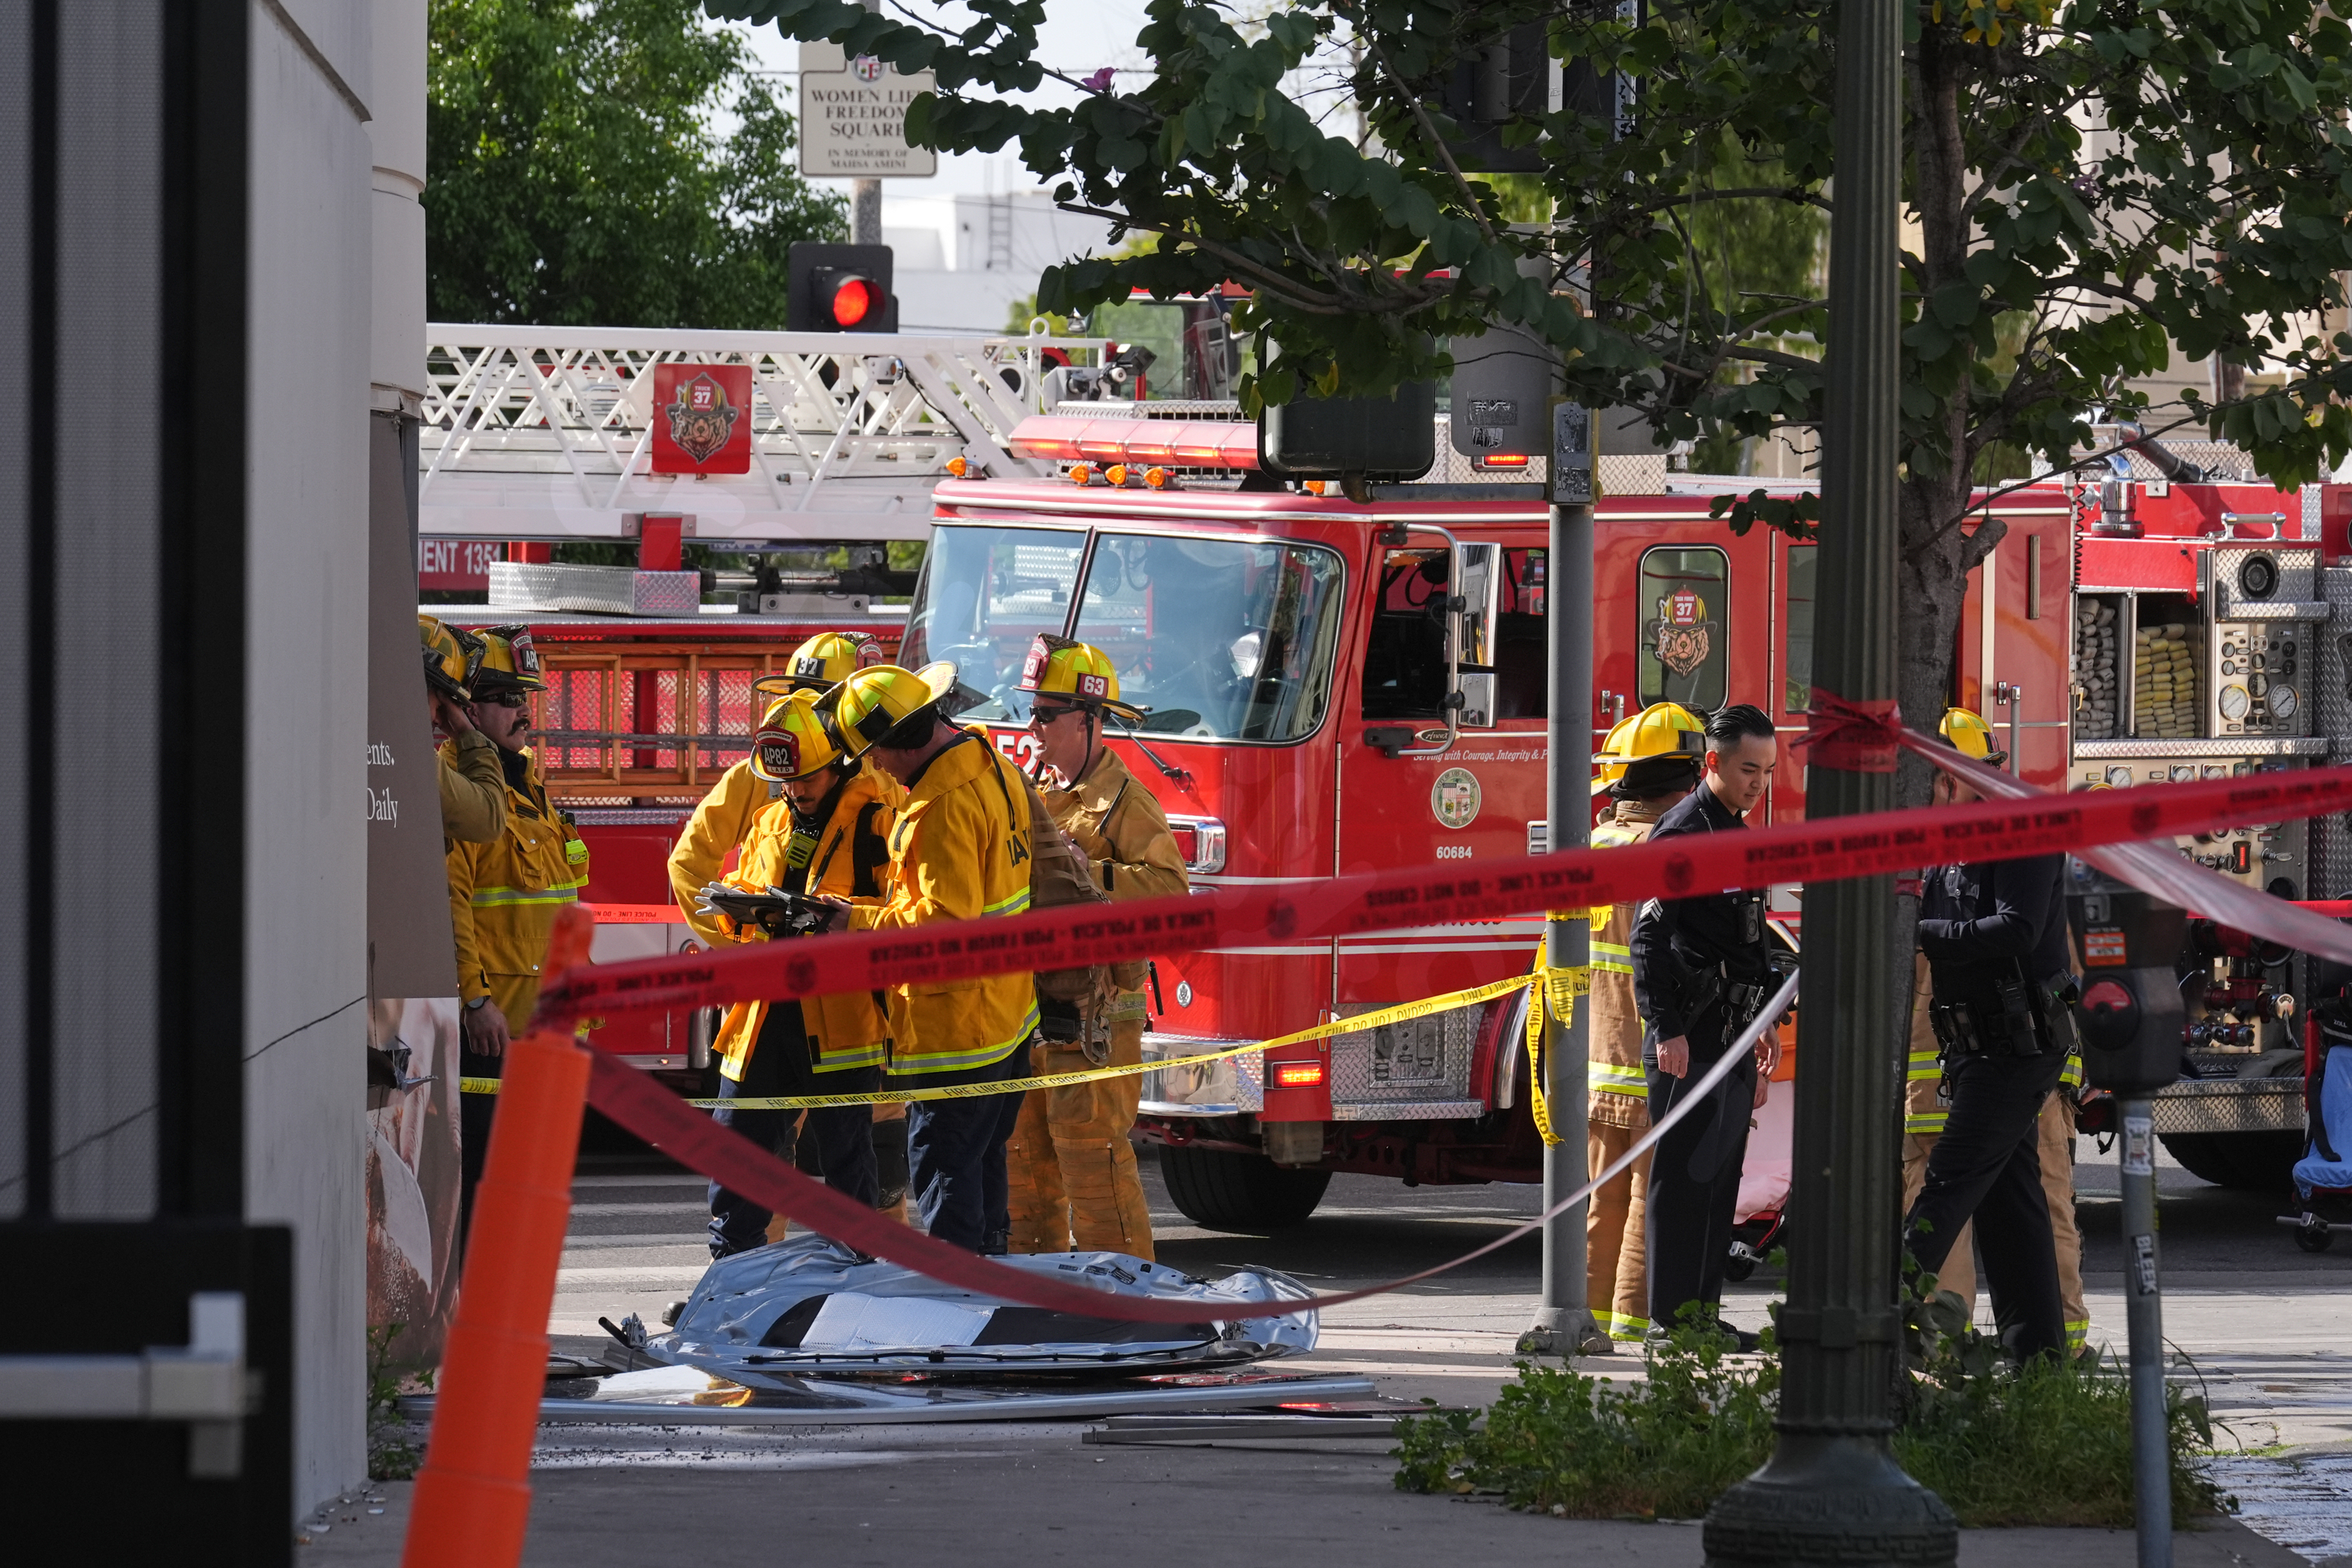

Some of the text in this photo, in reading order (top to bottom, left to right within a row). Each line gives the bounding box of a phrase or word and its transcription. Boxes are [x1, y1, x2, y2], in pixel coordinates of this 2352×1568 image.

[811, 89, 924, 103] WOMEN LIF
[830, 122, 904, 139] SQUARE
[828, 149, 908, 158] IN MEMORY OF
[830, 160, 906, 169] MAHSA AMINI
[694, 391, 711, 405] 37
[1676, 602, 1693, 616] 37
[798, 656, 818, 675] 37
[1023, 657, 1037, 676] 63
[1083, 675, 1105, 695] 63
[764, 747, 789, 765] AP82
[1444, 750, 1461, 761] with
[1462, 750, 1495, 762] Courage,
[1496, 749, 1530, 762] Integrity
[1530, 749, 1540, 760] &
[1436, 776, 1445, 789] CITY
[1461, 771, 1477, 789] ANGELES
[367, 786, 398, 829] Daily
[1436, 846, 1473, 859] 60684
[1142, 916, 1163, 933] DE
[1166, 910, 1216, 930] LINEA
[1022, 927, 1057, 945] POR
[1071, 919, 1137, 940] POLICIA
[870, 939, 937, 961] CRUZAR
[937, 937, 964, 954] NO
[966, 931, 1019, 951] FAVOR
[2333, 1019, 2348, 1029] ZOLL
[942, 1087, 975, 1096] FIRE
[973, 1083, 1000, 1094] LINE
[1022, 1079, 1047, 1088] NOT
[766, 1091, 916, 1109] FIRE LINE DO NOT CROSS
[2136, 1234, 2157, 1295] BLEEK
